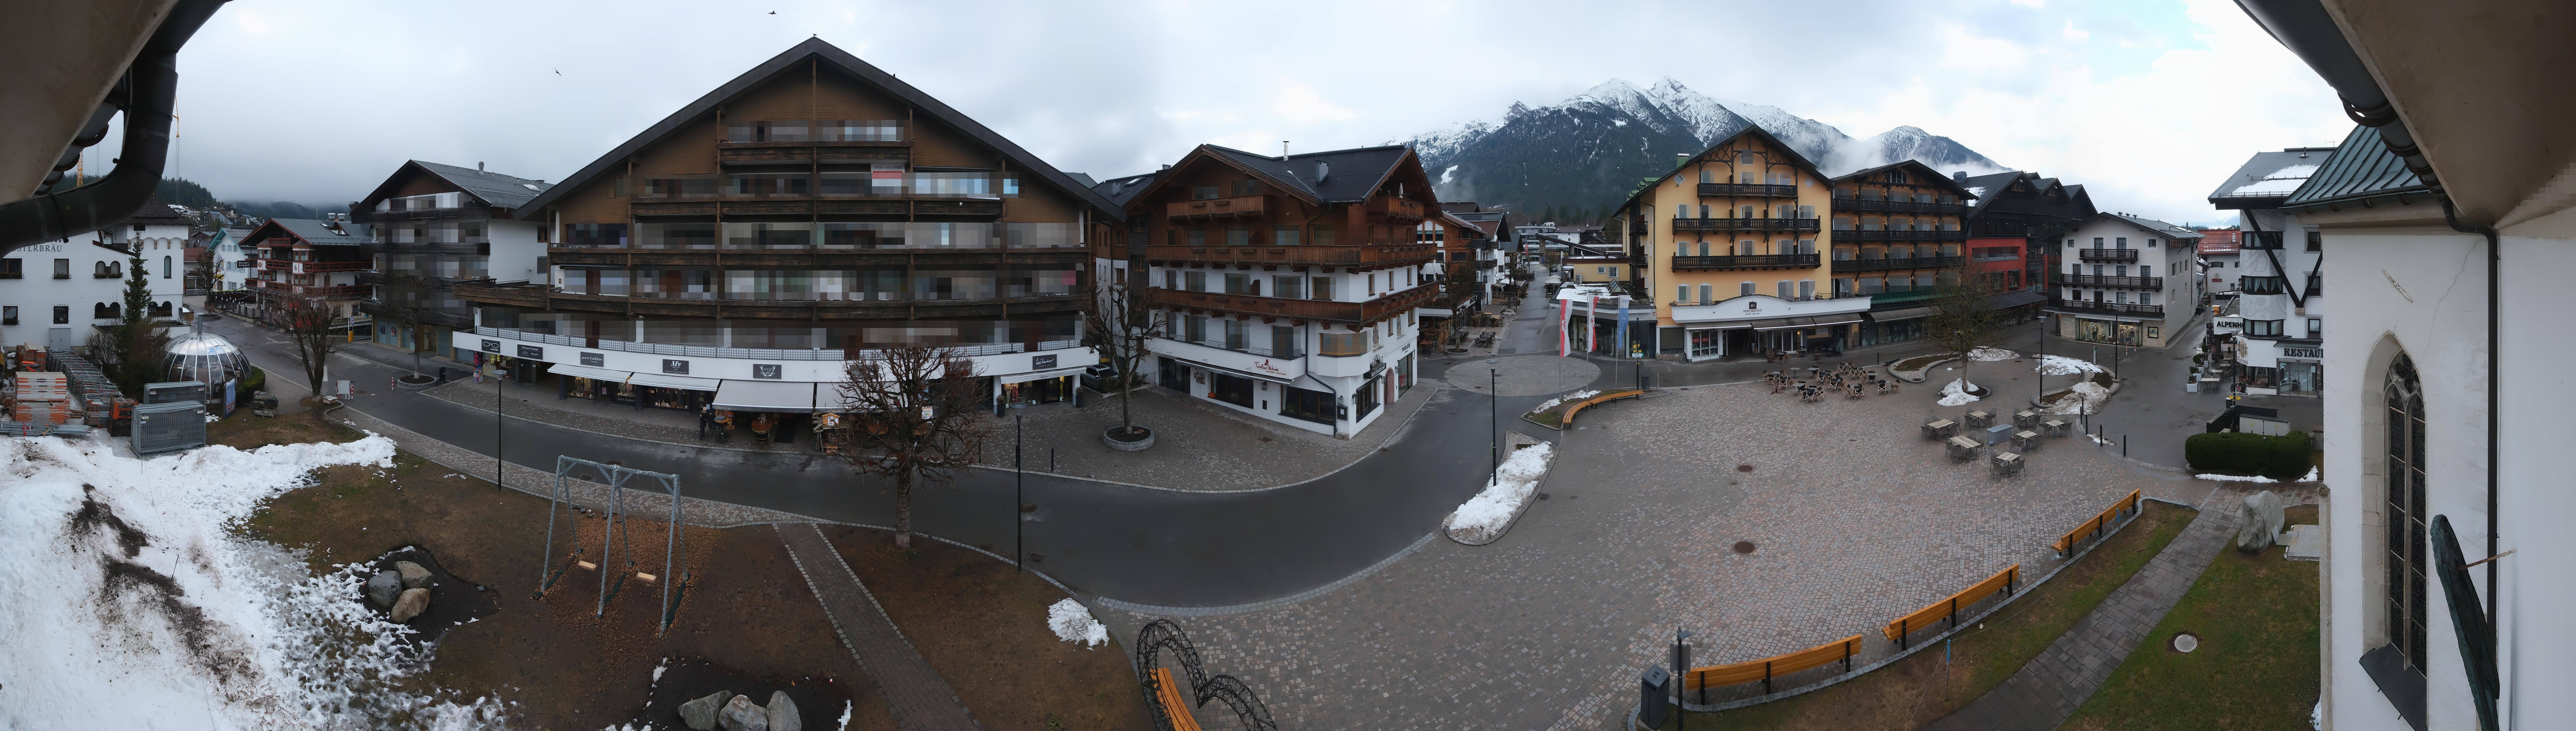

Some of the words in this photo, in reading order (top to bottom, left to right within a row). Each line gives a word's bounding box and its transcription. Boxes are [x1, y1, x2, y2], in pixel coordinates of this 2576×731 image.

[1402, 343, 1410, 352] SAILER
[670, 361, 681, 370] My
[1371, 364, 1385, 377] RESTAURANT
